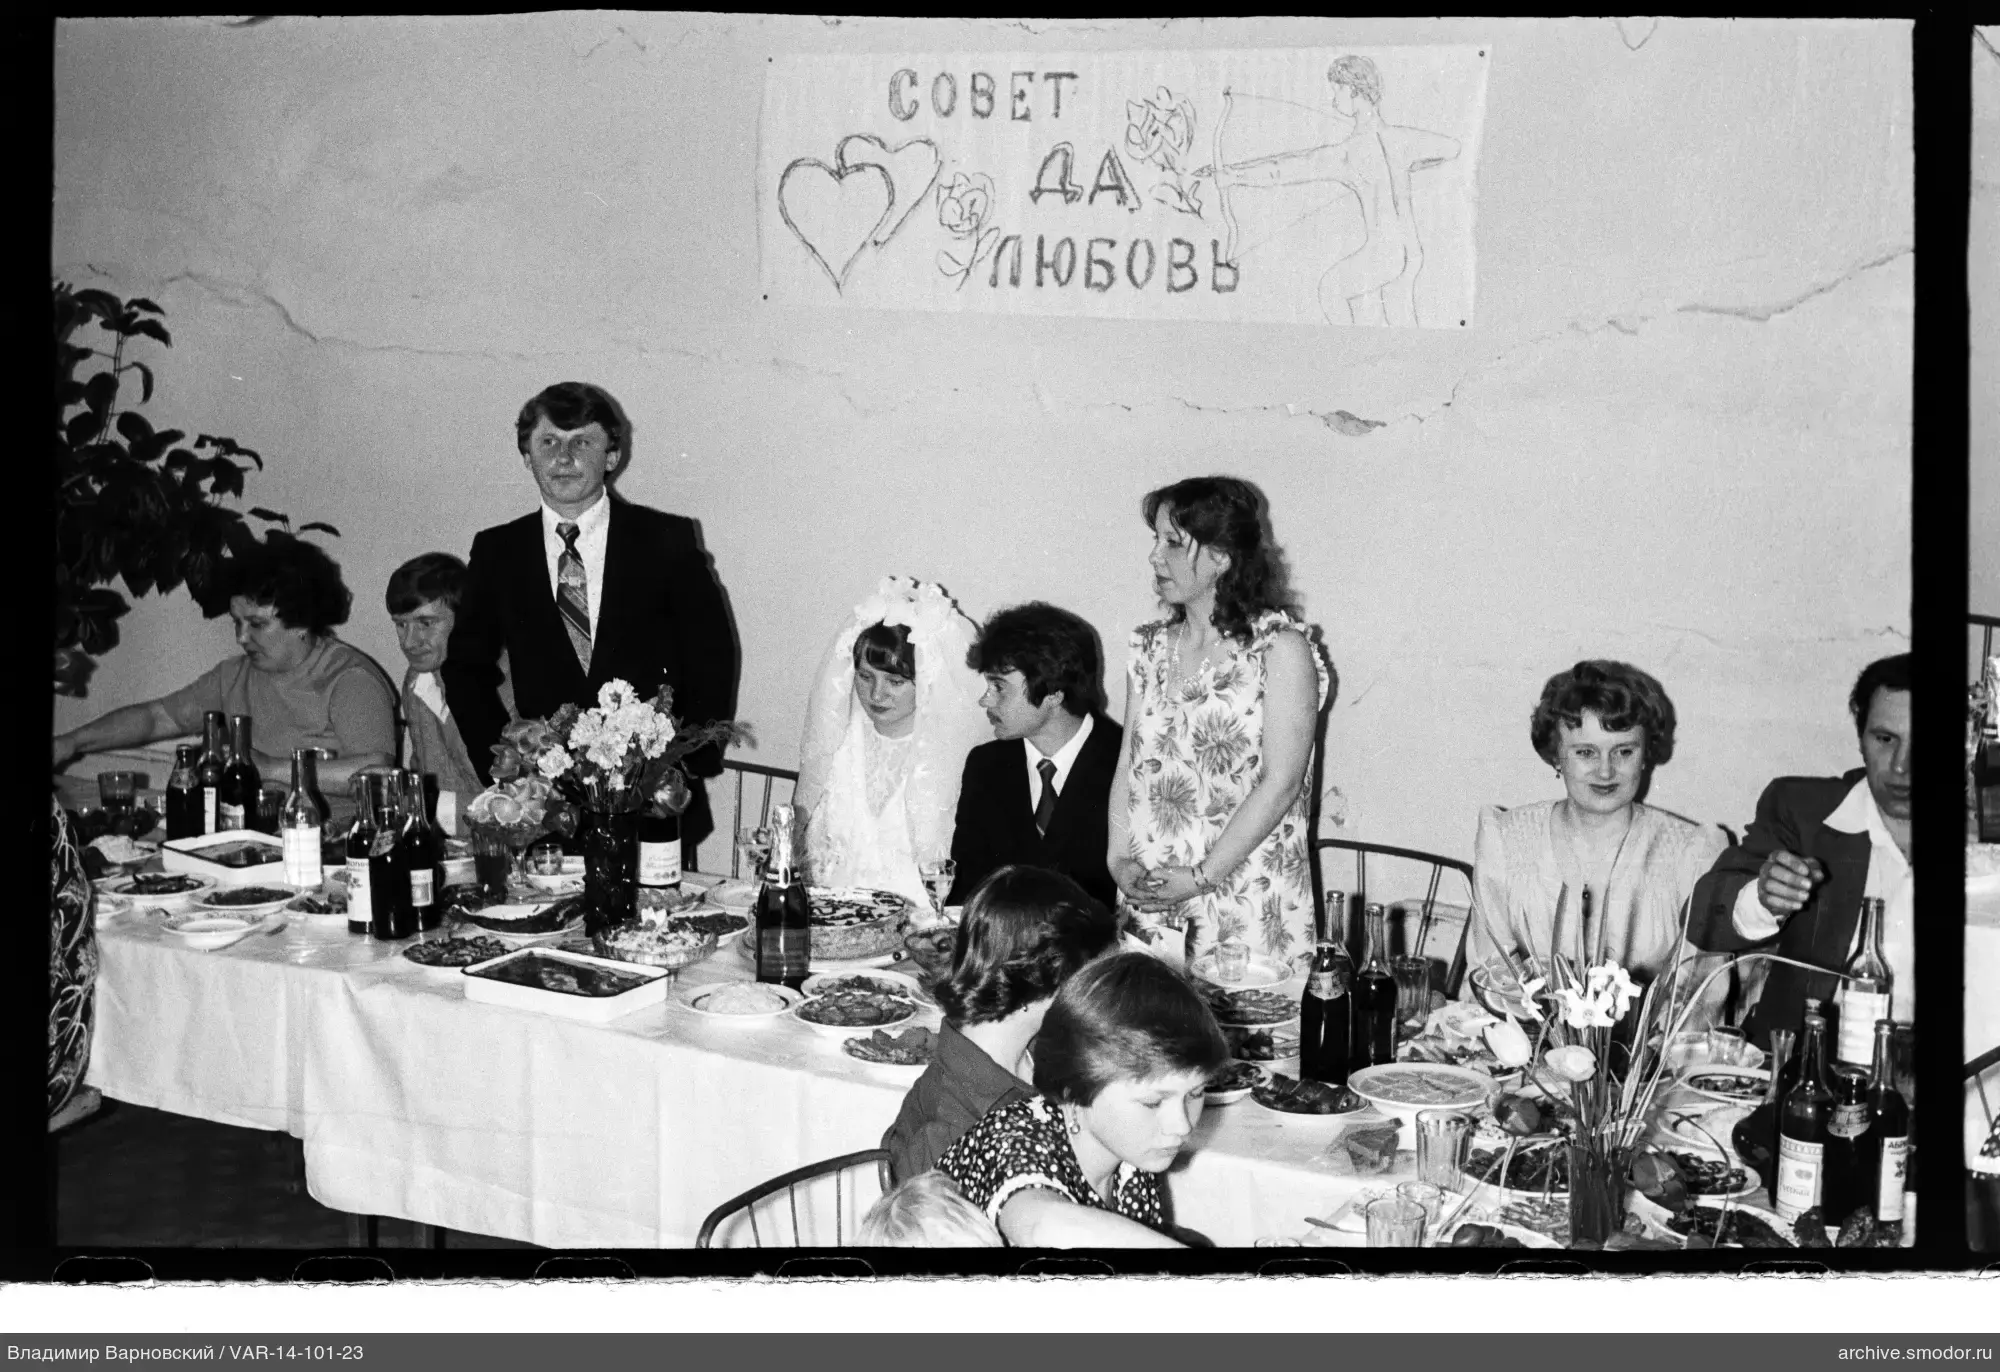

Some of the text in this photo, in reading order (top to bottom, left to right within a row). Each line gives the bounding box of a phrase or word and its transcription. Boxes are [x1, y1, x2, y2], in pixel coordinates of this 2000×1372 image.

[887, 69, 1080, 122] СОВЕТ
[1029, 141, 1142, 212] ДА
[988, 234, 1241, 294] ЛЮБОВЬ
